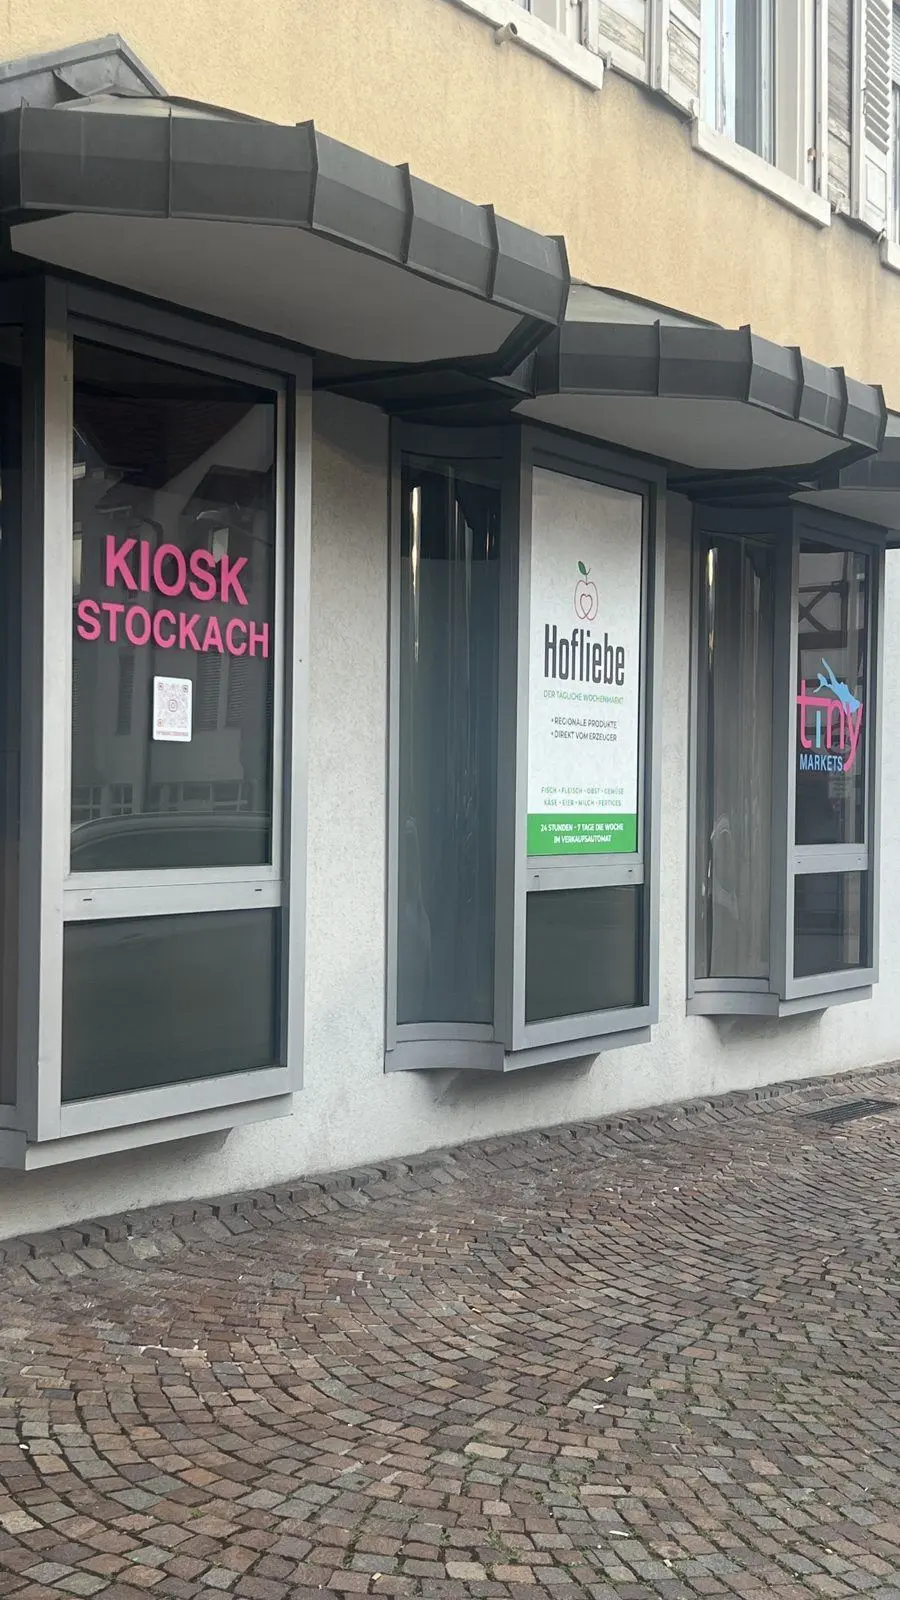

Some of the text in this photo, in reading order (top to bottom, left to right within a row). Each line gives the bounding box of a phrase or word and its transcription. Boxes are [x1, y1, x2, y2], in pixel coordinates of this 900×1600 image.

[106, 534, 249, 605] KIOSK
[77, 599, 269, 658] STOCKACH
[544, 623, 625, 686] Hofliebe
[543, 689, 556, 698] DER
[554, 717, 617, 729] REGIONALE PRODUKTE
[796, 679, 864, 772] tiny
[554, 730, 617, 741] DIREKT VOM ERZEUGER
[800, 753, 843, 771] MARKETS
[540, 824, 548, 832] 24
[548, 823, 573, 832] STUNDEN
[581, 823, 595, 831] TAGE
[595, 823, 604, 831] DIE
[605, 822, 625, 831] WOCHE
[553, 834, 612, 844] IM VERKAUFSAUTOMAT
